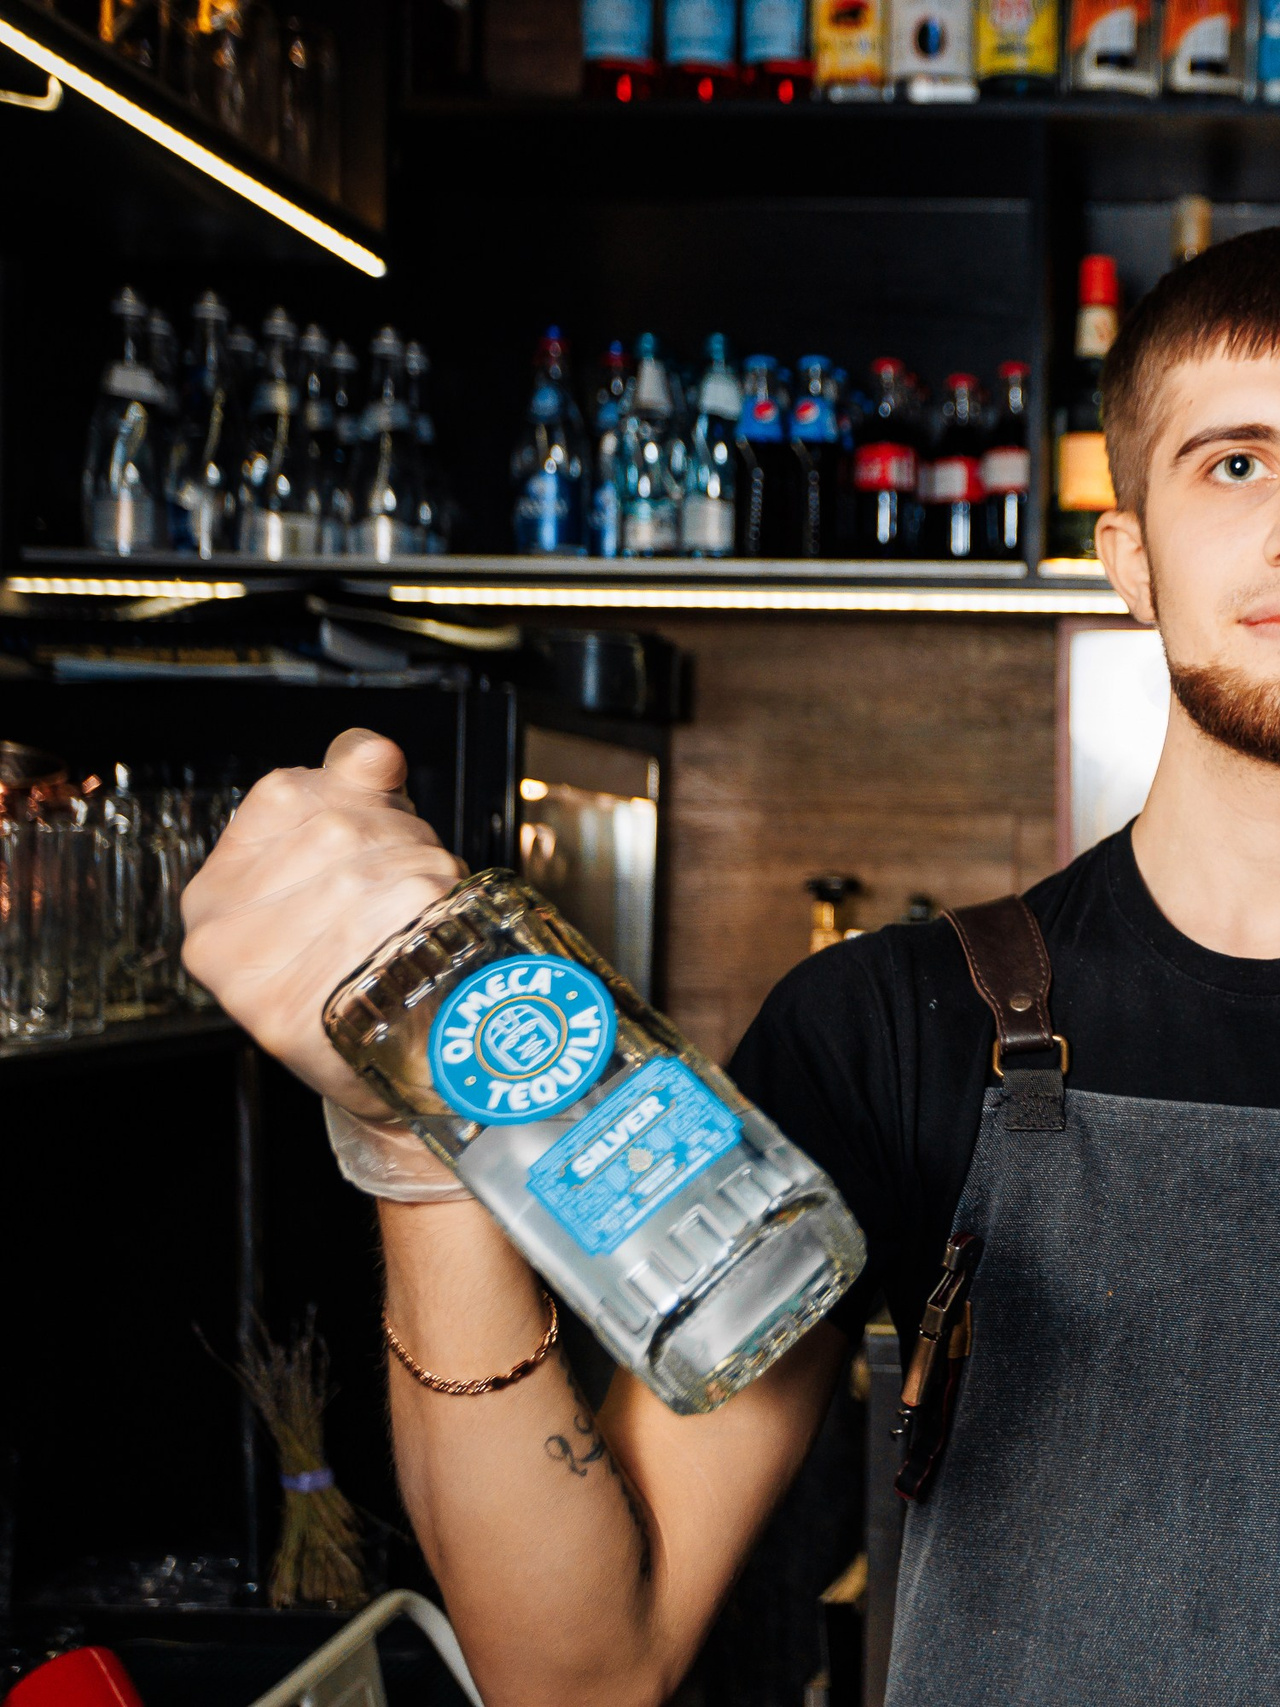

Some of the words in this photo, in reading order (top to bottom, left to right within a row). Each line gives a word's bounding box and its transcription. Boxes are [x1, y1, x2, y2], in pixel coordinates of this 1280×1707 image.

[441, 967, 552, 1064] OLMECA
[486, 1005, 602, 1111] TEQUILA
[571, 1095, 665, 1178] SILVER
